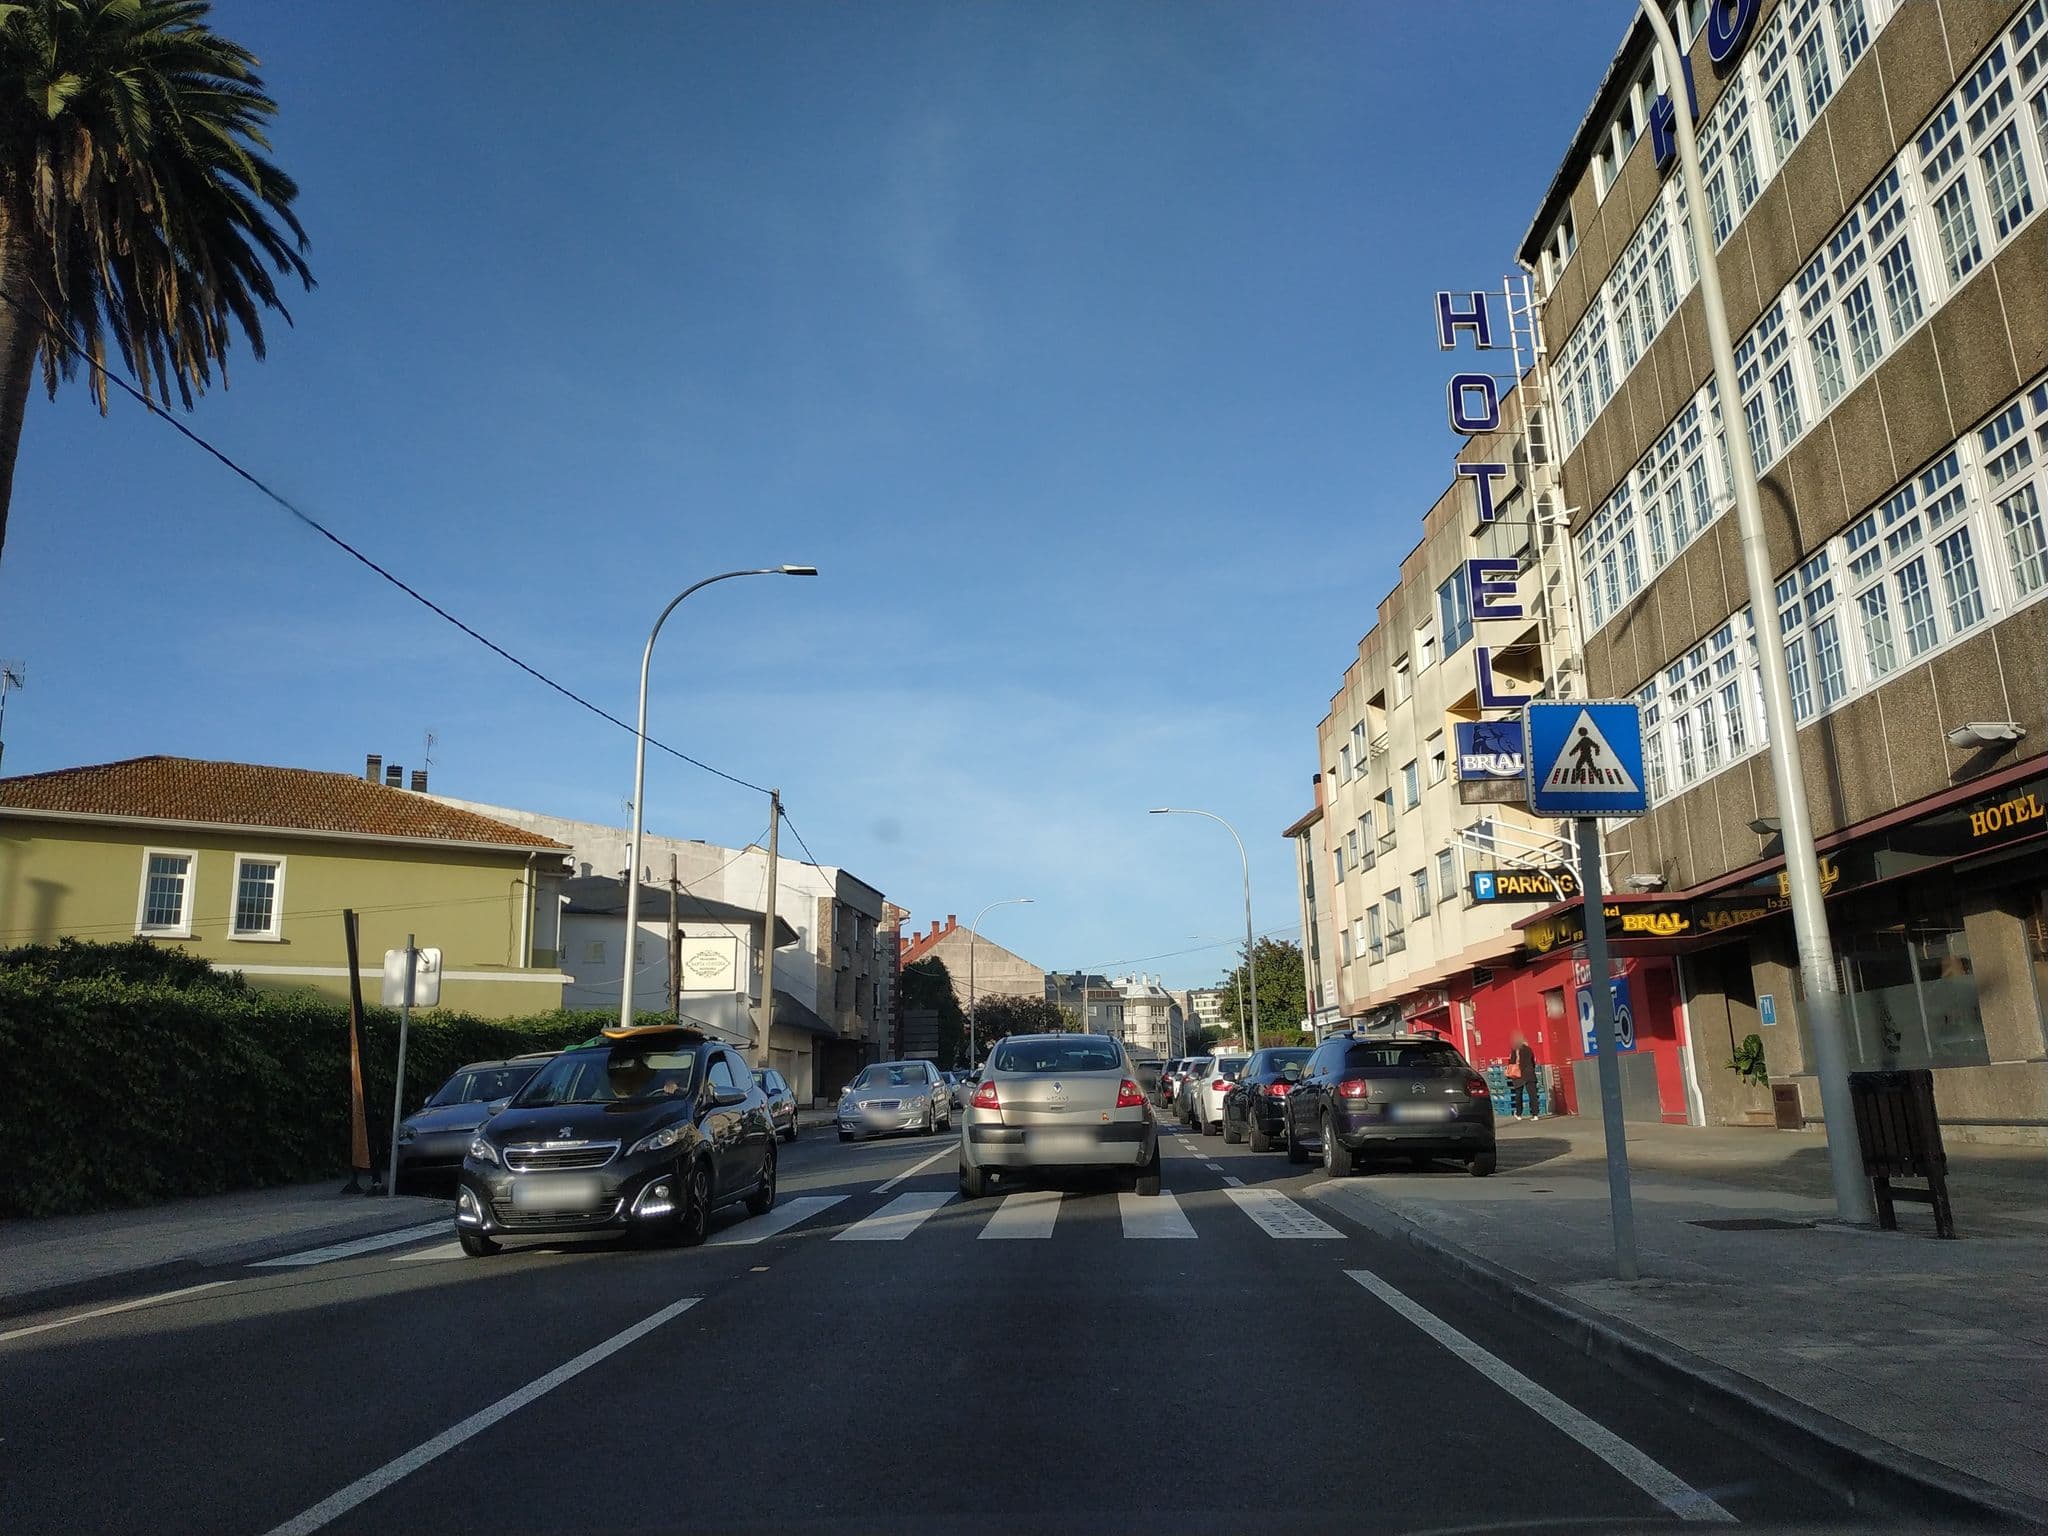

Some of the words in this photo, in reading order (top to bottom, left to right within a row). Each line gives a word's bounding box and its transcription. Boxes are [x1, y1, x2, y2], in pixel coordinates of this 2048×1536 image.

[1436, 291, 1531, 708] HOTEL
[1462, 753, 1525, 776] BRIAL
[1970, 794, 2044, 837] HOTEL
[1623, 913, 1689, 935] BRIAL
